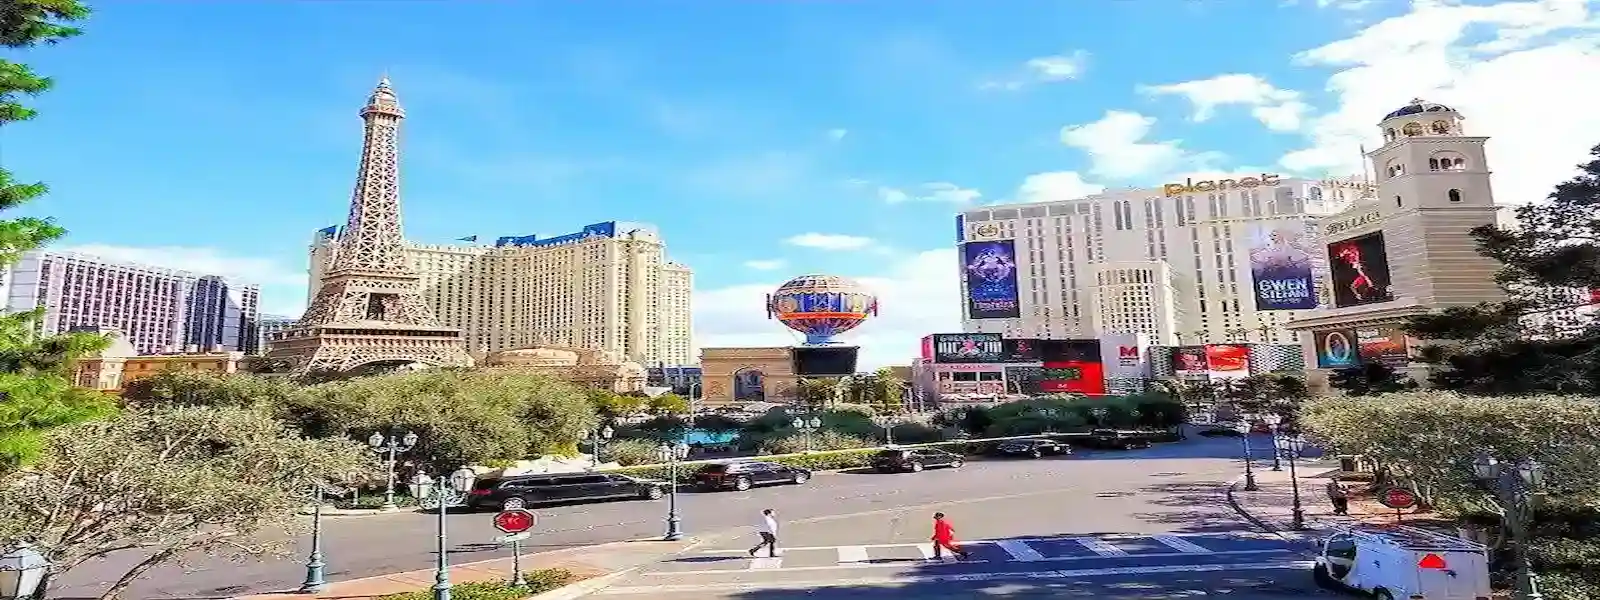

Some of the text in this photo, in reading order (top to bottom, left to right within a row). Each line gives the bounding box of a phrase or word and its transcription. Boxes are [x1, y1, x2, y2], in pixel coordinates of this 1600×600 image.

[1164, 174, 1280, 197] planet
[1258, 278, 1307, 292] GWEN
[1119, 345, 1138, 357] M
